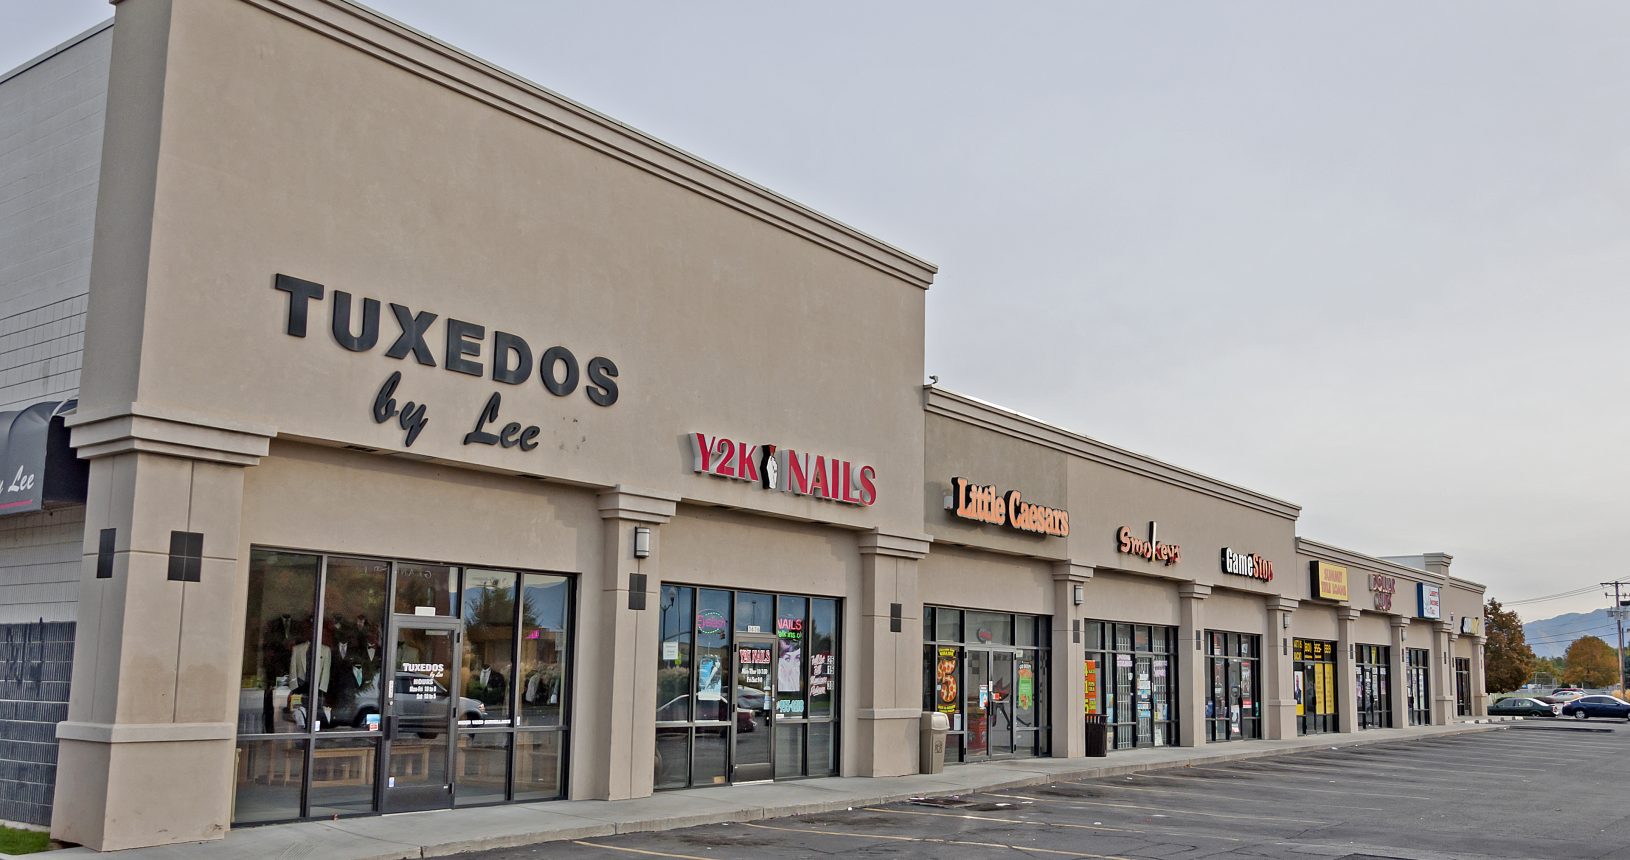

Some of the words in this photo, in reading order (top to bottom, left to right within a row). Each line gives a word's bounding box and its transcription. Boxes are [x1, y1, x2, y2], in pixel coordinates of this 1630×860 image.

[274, 273, 619, 407] TUXEDOS
[373, 371, 428, 448] by
[464, 391, 541, 451] Lee
[8, 465, 35, 492] Lee
[690, 432, 759, 483] Y2K
[785, 449, 877, 506] NAILS
[953, 476, 1006, 526] Little
[1007, 489, 1070, 537] Caesars
[1117, 521, 1181, 567] Smokeys
[1222, 546, 1274, 583] GameStop
[403, 663, 444, 672] TUXEDOS
